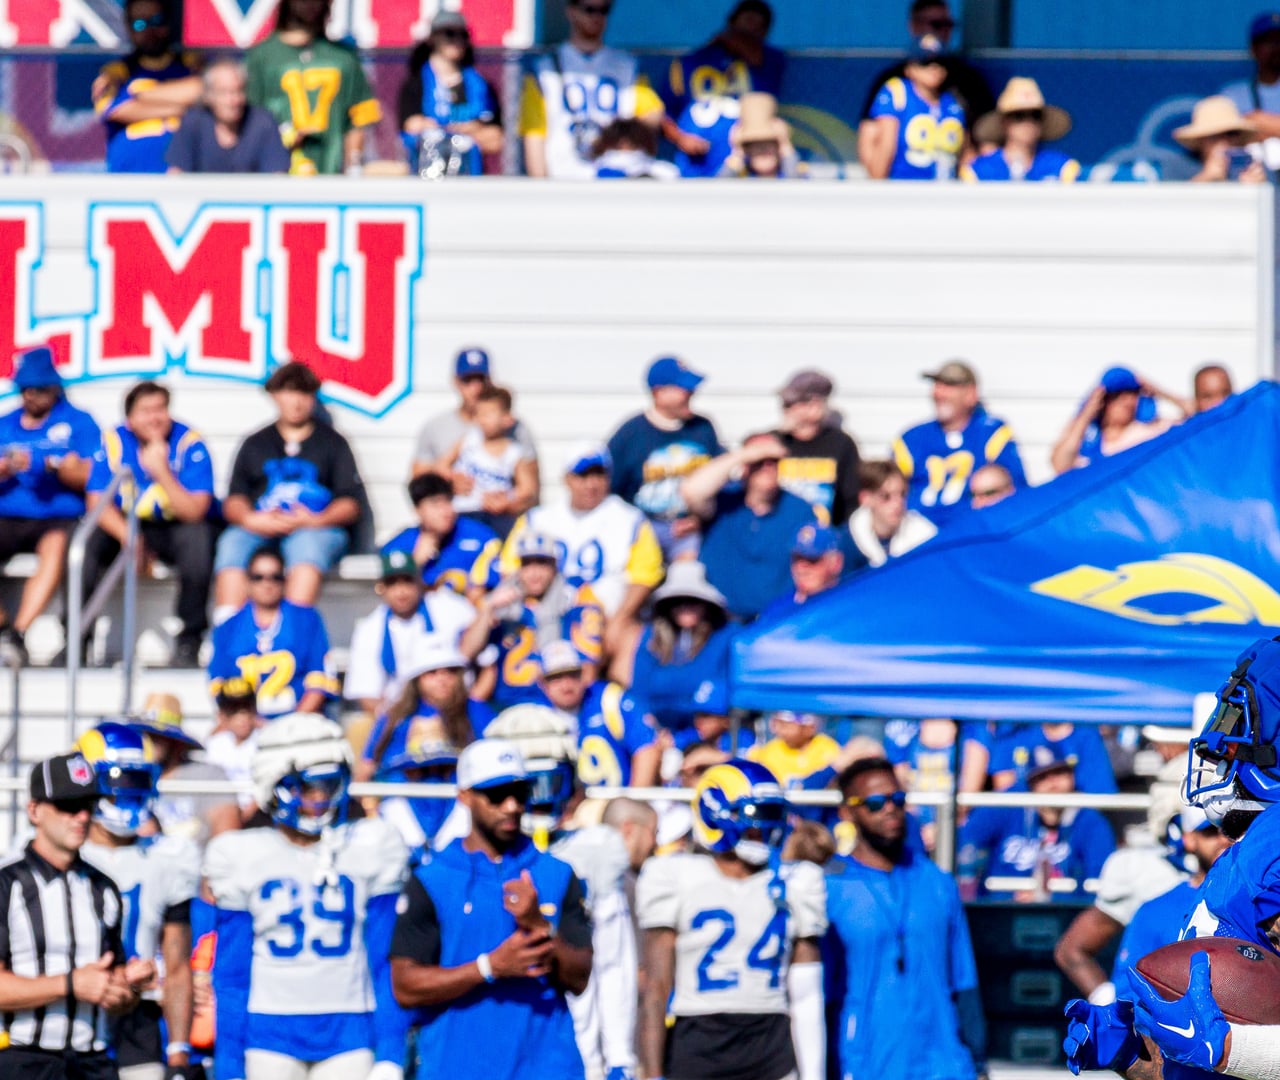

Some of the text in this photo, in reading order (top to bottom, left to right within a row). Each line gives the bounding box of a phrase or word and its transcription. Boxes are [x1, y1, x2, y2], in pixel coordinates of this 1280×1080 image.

[281, 68, 341, 132] 17
[920, 449, 975, 507] 17
[260, 874, 355, 957] 39
[691, 908, 790, 993] 24
[1243, 949, 1258, 960] 037
